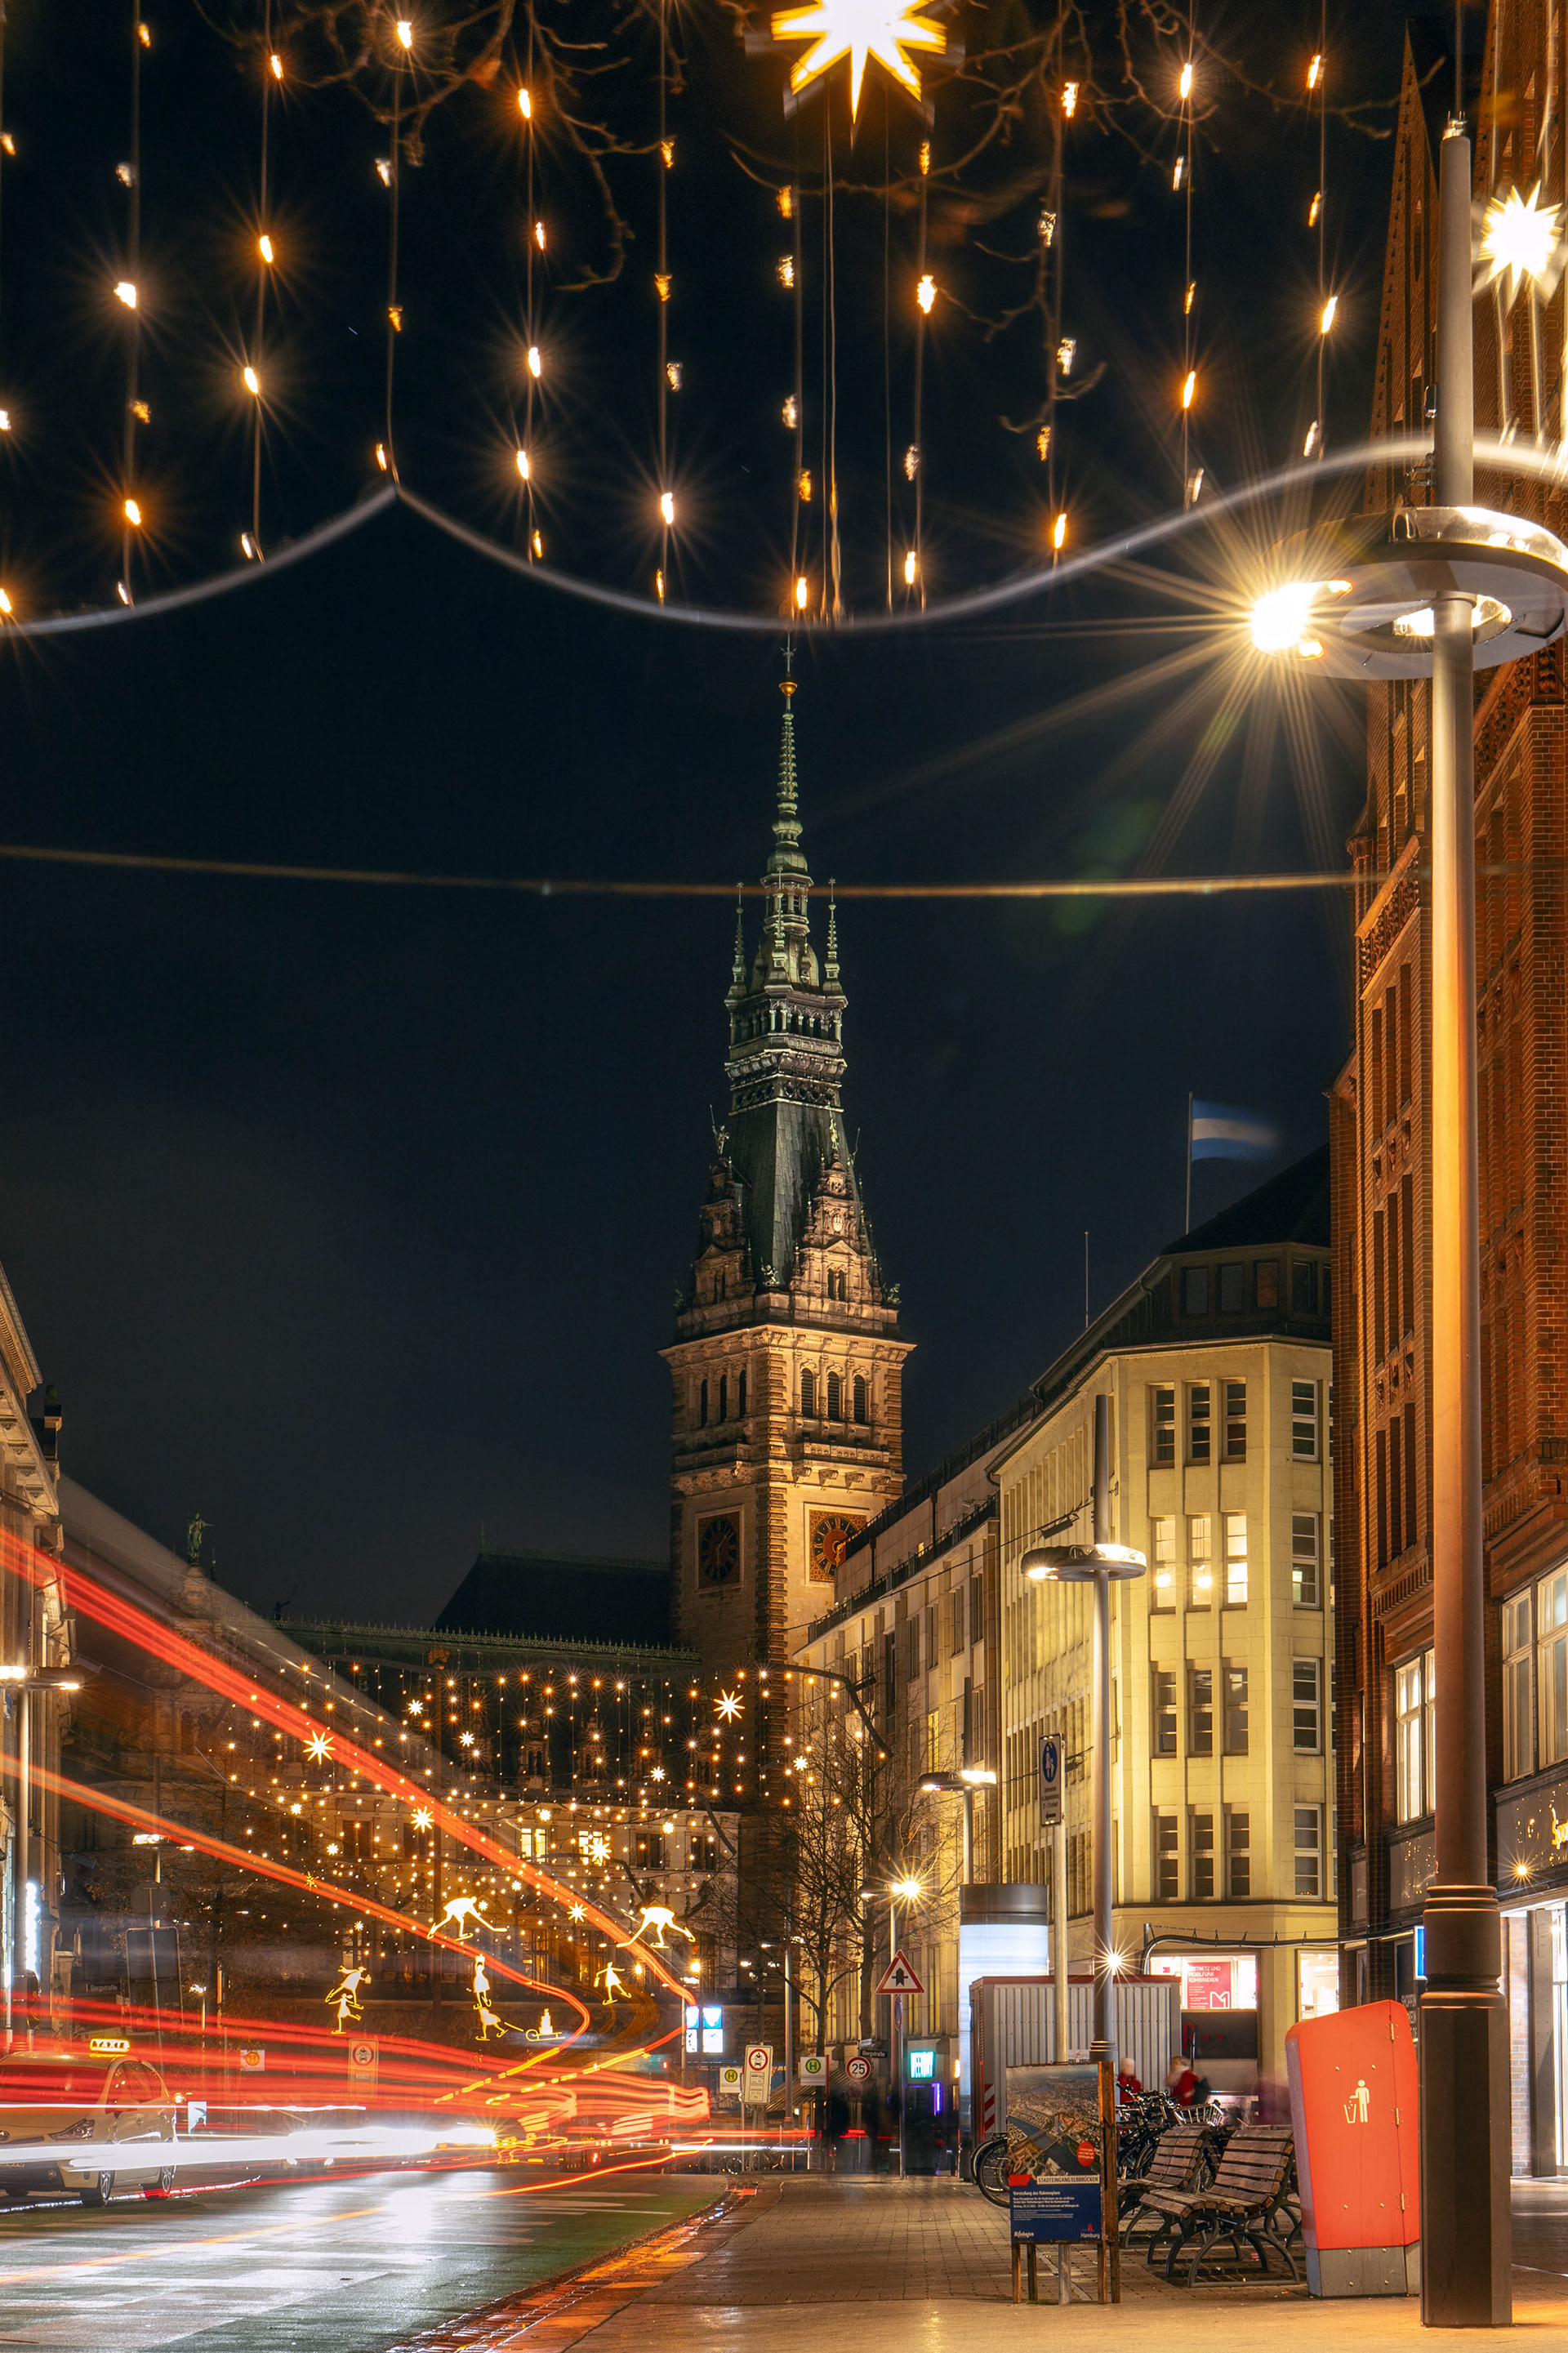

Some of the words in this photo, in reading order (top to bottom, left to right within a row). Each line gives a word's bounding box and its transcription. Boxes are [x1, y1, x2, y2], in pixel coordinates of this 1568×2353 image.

[91, 2040, 125, 2049] TAXI
[809, 2061, 817, 2070] H
[851, 2063, 866, 2075] 25
[728, 2072, 735, 2080] H
